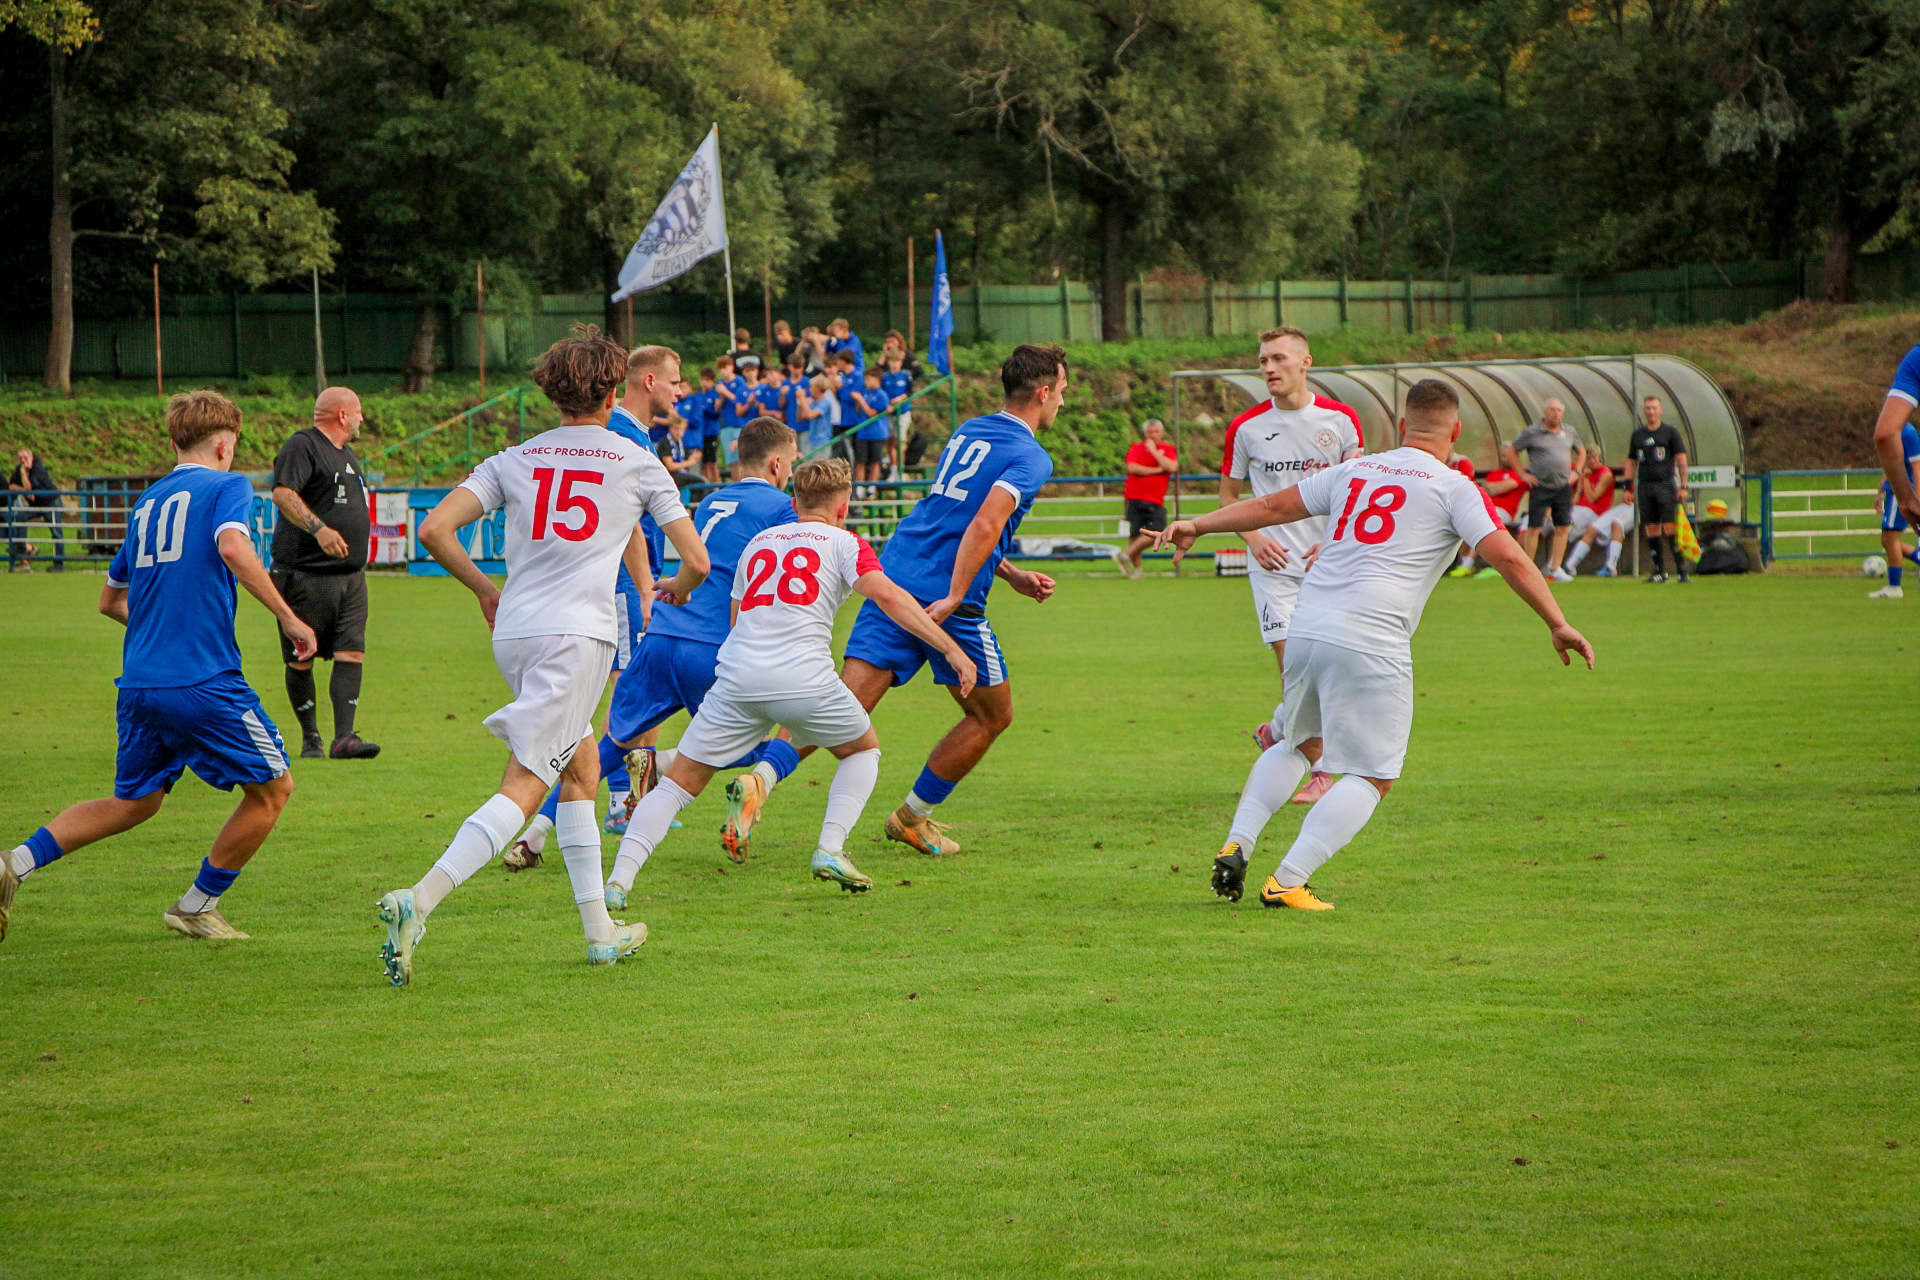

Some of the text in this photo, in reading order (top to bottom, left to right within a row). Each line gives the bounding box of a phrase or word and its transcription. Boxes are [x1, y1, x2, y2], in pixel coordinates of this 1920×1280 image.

[522, 447, 625, 462] OBEC PROBOŠTOV
[930, 434, 992, 501] 12
[1264, 460, 1305, 473] HOTEL
[1376, 464, 1434, 480] PROBOŠTOV
[133, 490, 192, 569] 10
[532, 467, 605, 542] 15
[700, 500, 739, 545] 7
[1332, 477, 1407, 545] 18
[740, 546, 821, 612] 28
